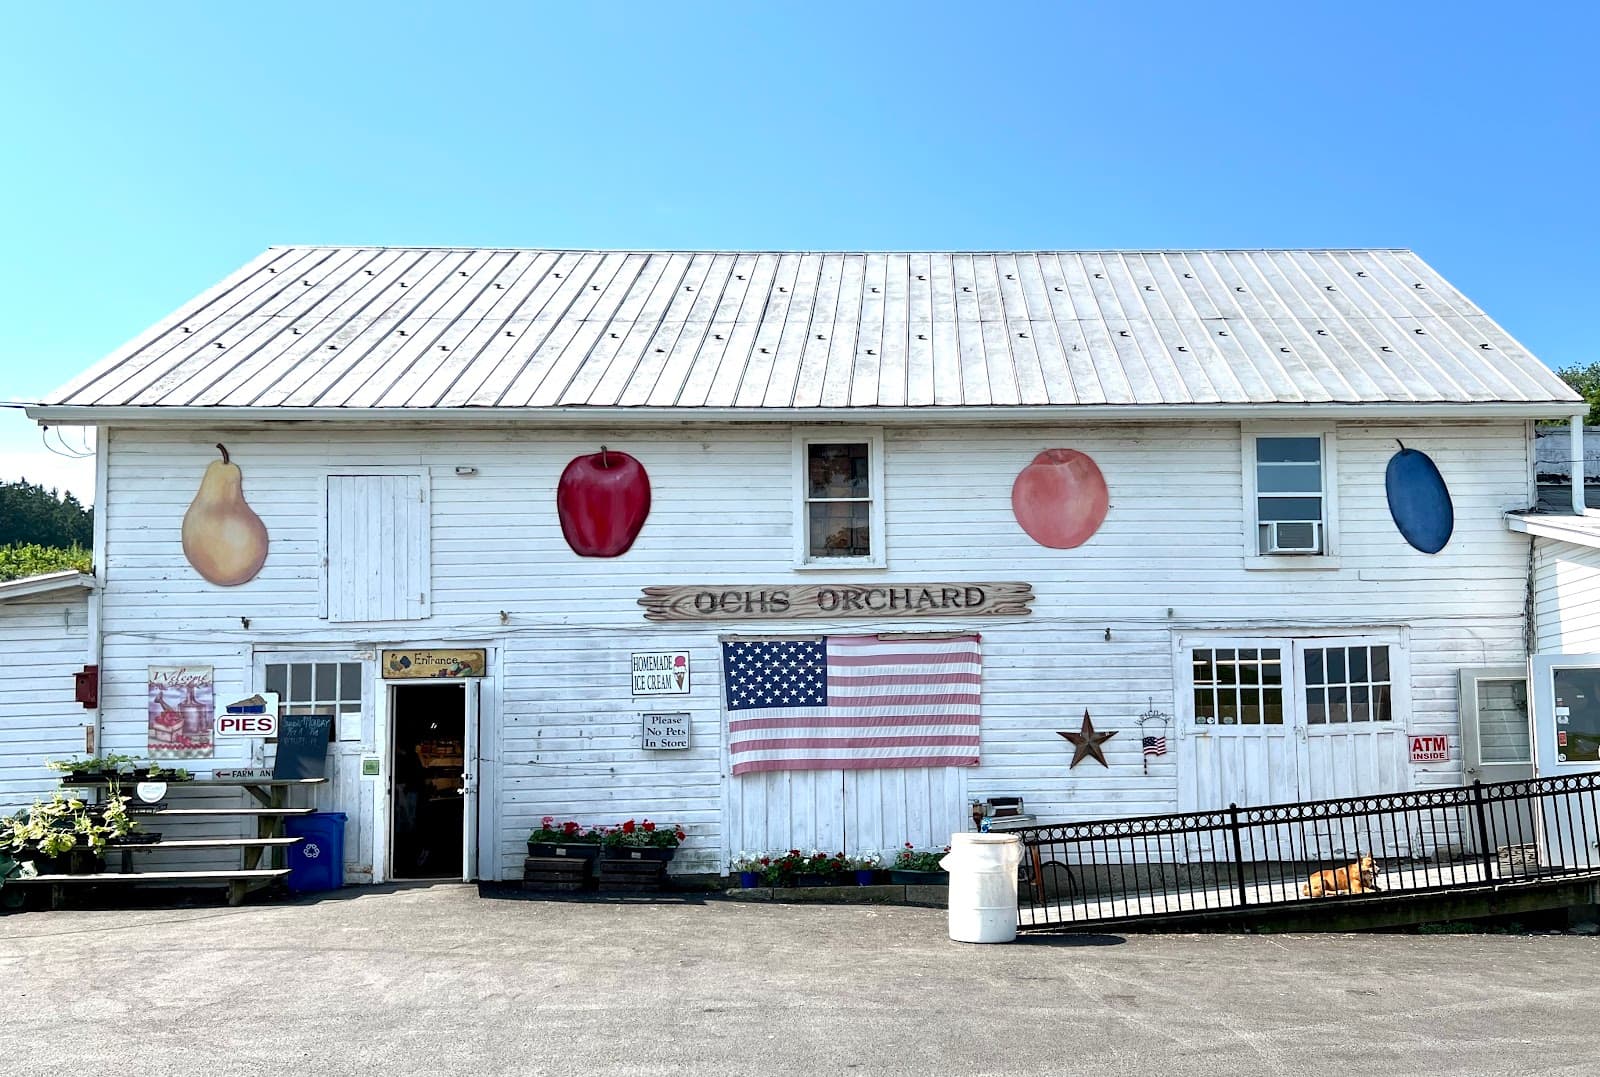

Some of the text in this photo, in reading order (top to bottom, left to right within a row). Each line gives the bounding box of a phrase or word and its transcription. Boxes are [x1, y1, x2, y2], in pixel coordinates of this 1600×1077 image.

[694, 586, 986, 614] OCHS ORCHARD
[414, 652, 458, 665] Entrance
[633, 655, 673, 672] HOMEMADE
[153, 667, 208, 682] Welcome
[634, 674, 672, 691] ICE CREAM
[220, 718, 272, 732] PIES
[651, 716, 682, 724] Please
[647, 727, 686, 736] No Pets
[645, 738, 687, 747] In Store
[1412, 737, 1446, 752] ATM
[1413, 752, 1445, 760] INSIDE
[232, 770, 254, 778] FARM
